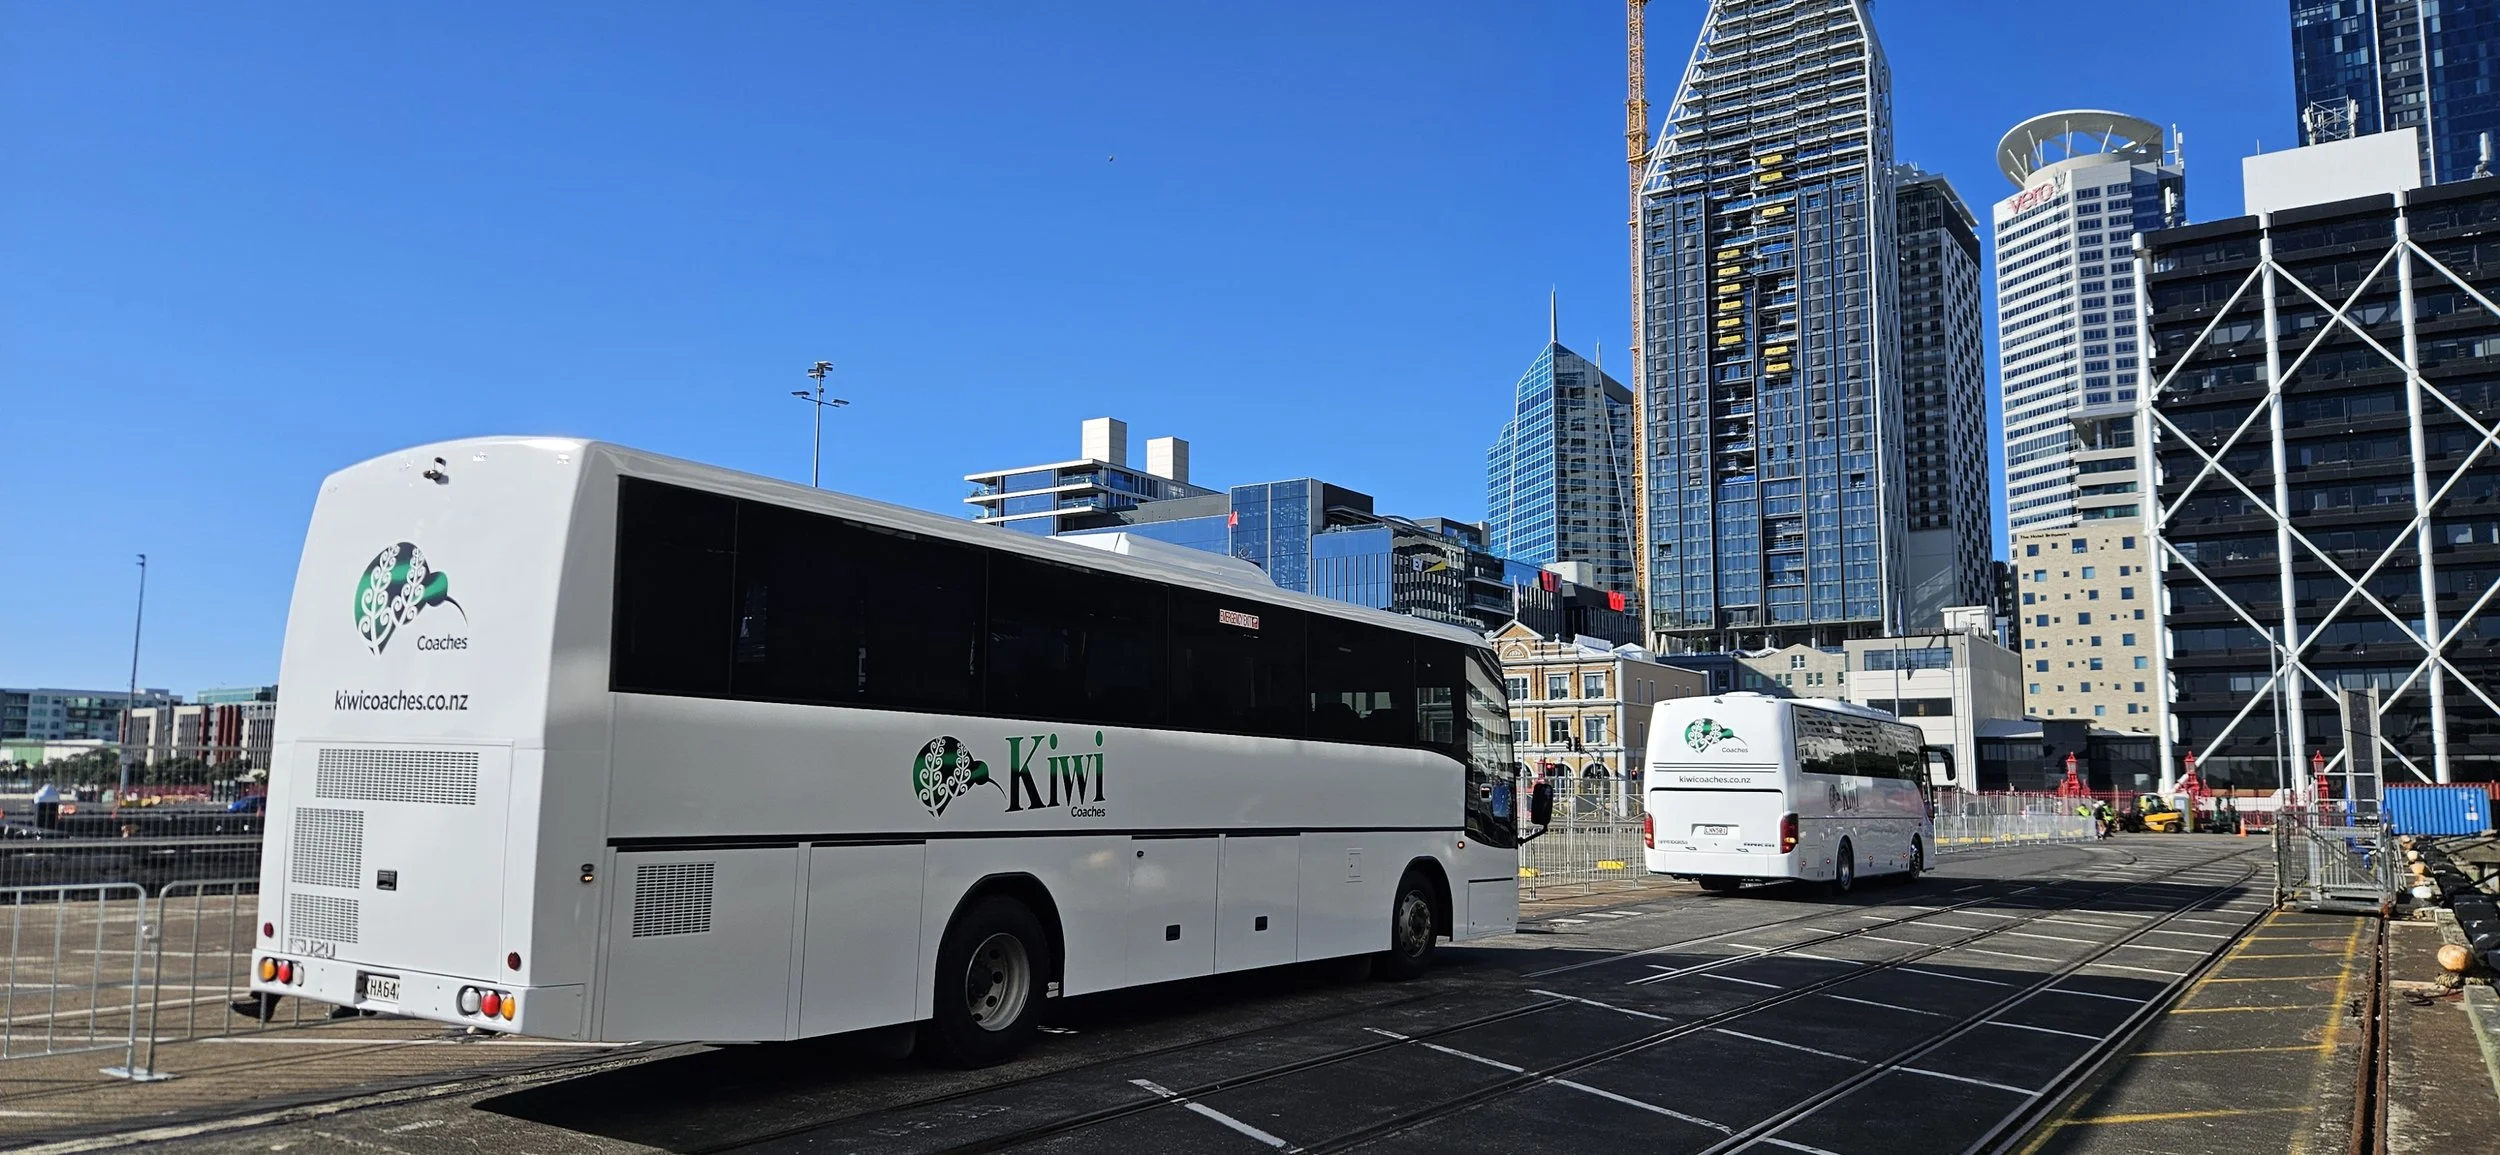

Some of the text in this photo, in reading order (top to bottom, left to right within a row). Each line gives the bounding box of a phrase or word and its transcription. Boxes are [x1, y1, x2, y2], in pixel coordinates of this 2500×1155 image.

[2009, 184, 2053, 214] vero
[1413, 558, 1423, 571] EY
[417, 634, 468, 651] Coaches
[334, 689, 469, 711] kiwicoaches.co.nz
[1004, 730, 1106, 813] Kiwi
[1679, 775, 1751, 784] kiwicoaches.co.nz
[1070, 805, 1106, 818] Coaches
[288, 938, 336, 959] ISUZU
